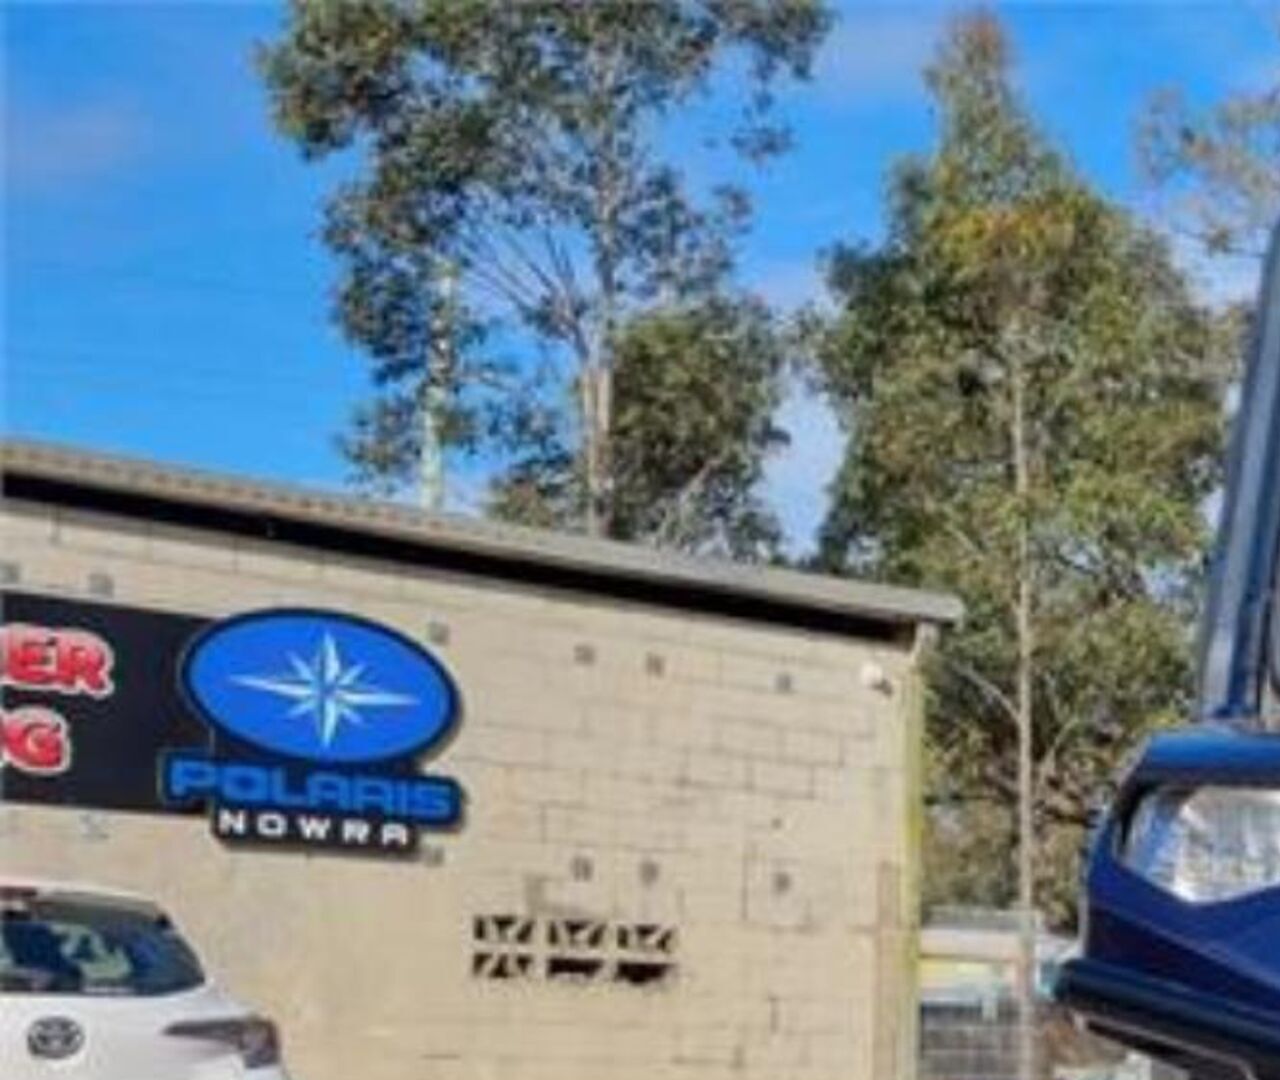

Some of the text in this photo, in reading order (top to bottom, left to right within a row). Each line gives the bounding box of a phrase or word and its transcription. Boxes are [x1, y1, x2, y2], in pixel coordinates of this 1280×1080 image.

[0, 622, 114, 699] ER
[0, 704, 71, 777] G
[170, 759, 455, 820] POLARIS
[217, 808, 409, 846] NOWRA
